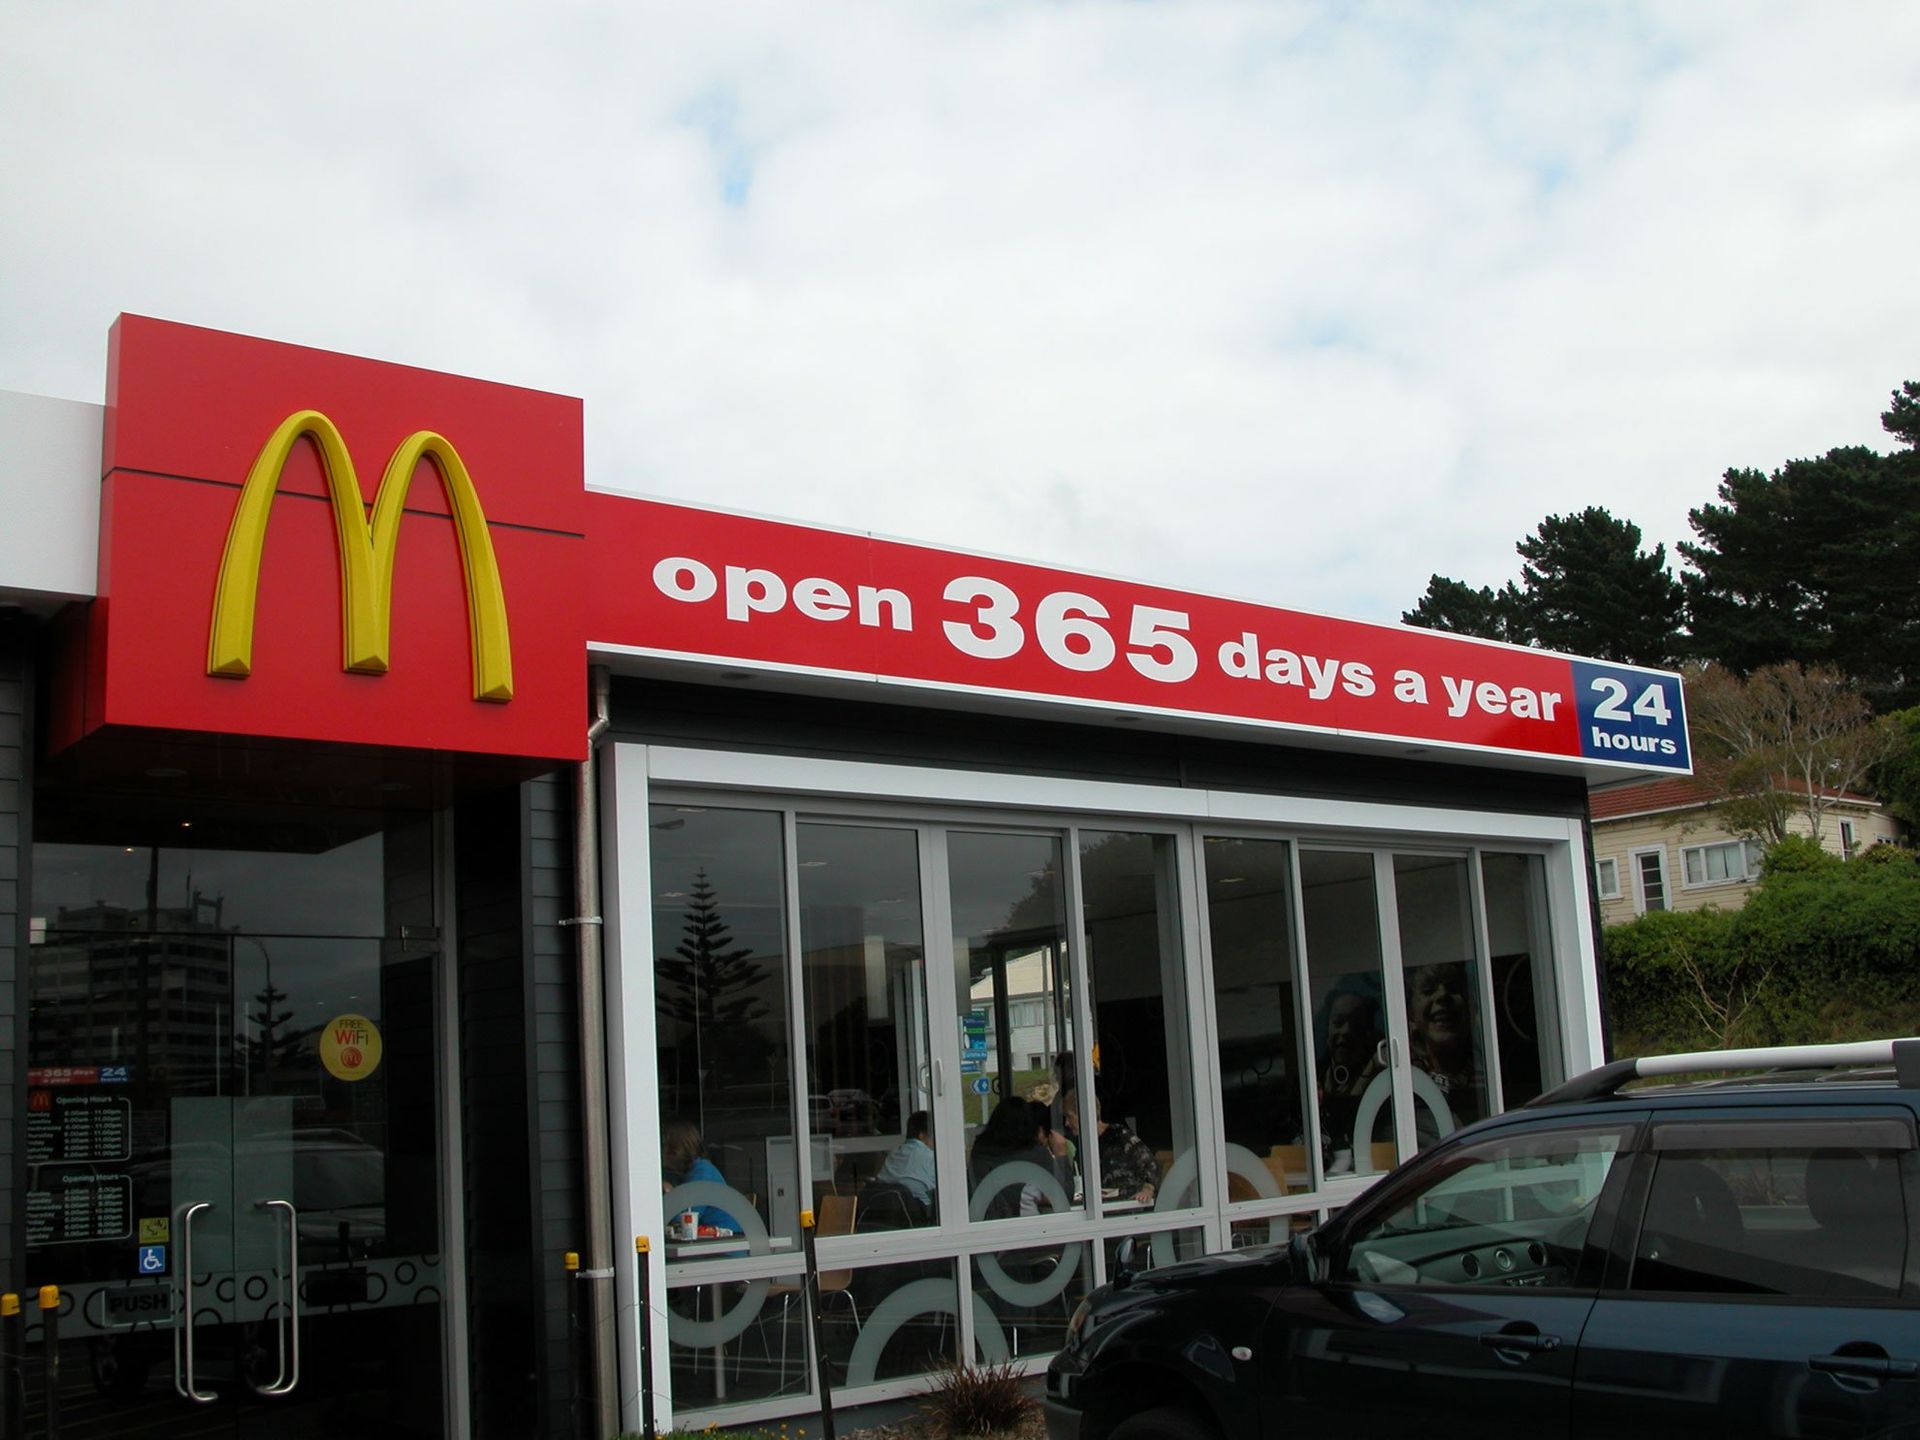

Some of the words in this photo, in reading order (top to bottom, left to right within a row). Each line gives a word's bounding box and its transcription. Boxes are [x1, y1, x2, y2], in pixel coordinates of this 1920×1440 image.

[652, 555, 914, 632] open
[942, 575, 1199, 684] 365
[1217, 632, 1377, 700] days
[1393, 669, 1430, 705] a
[1440, 674, 1562, 722] year
[1589, 677, 1673, 726] 24
[1592, 726, 1677, 754] hours
[340, 1019, 364, 1029] FREE
[335, 1029, 369, 1046] WiFi
[43, 1067, 72, 1077] 365
[101, 1067, 127, 1077] 24
[56, 1096, 88, 1106] Opening
[89, 1095, 113, 1104] Hours
[62, 1174, 95, 1184] Opening
[96, 1173, 119, 1181] Hours
[110, 1292, 167, 1314] PUSH
